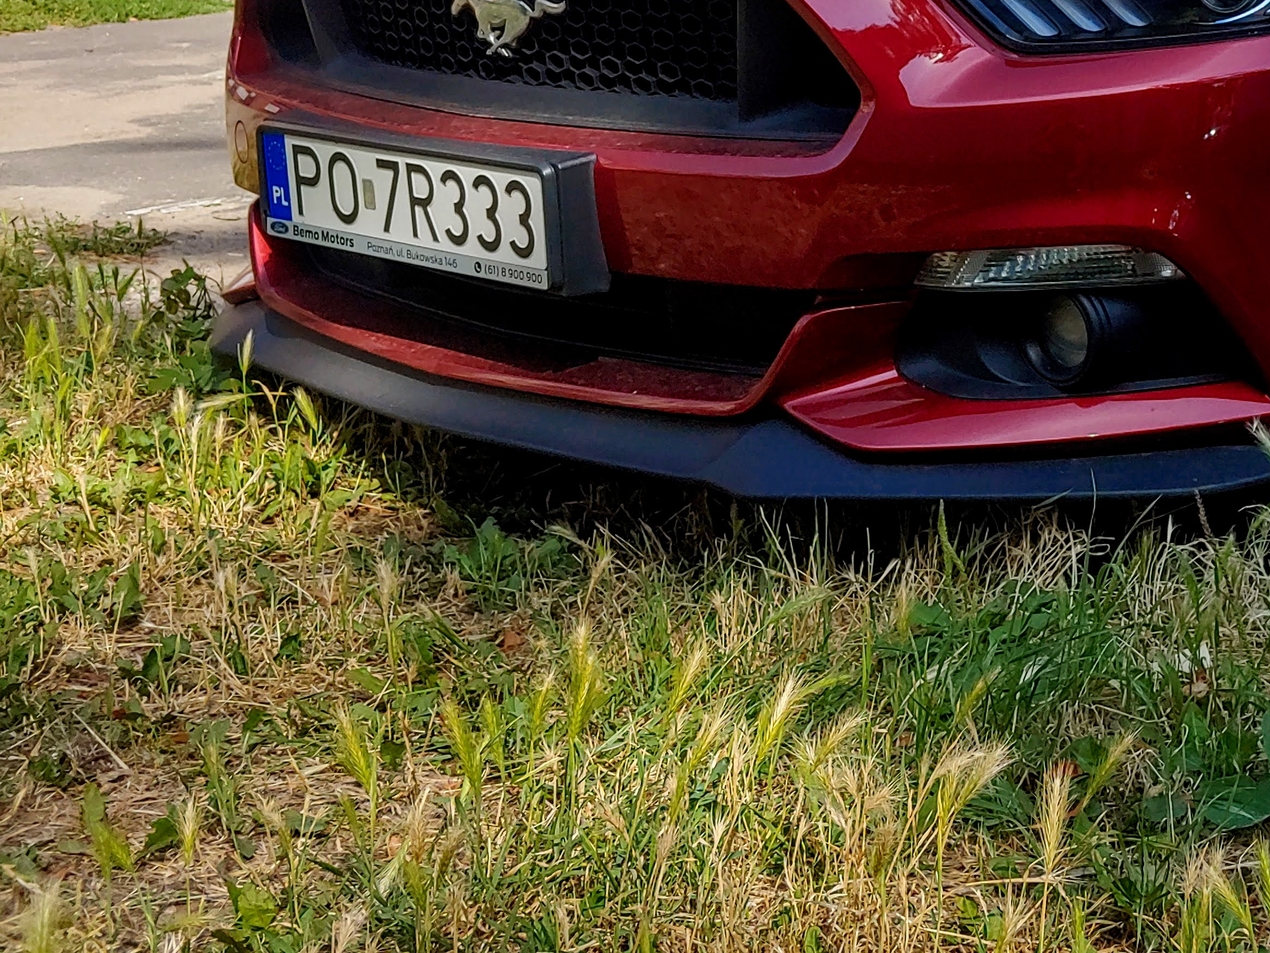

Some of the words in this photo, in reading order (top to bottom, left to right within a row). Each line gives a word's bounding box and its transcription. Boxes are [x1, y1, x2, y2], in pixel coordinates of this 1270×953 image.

[272, 185, 289, 206] PL
[292, 144, 359, 225] PO
[376, 158, 535, 259] 7R333
[293, 225, 320, 241] Bemo
[321, 230, 354, 248] Motors
[406, 249, 443, 266] Bukowska
[444, 256, 458, 269] 146
[484, 263, 500, 278] (61)
[501, 267, 507, 278] 8
[508, 268, 525, 281] 900
[526, 272, 543, 284] 900
